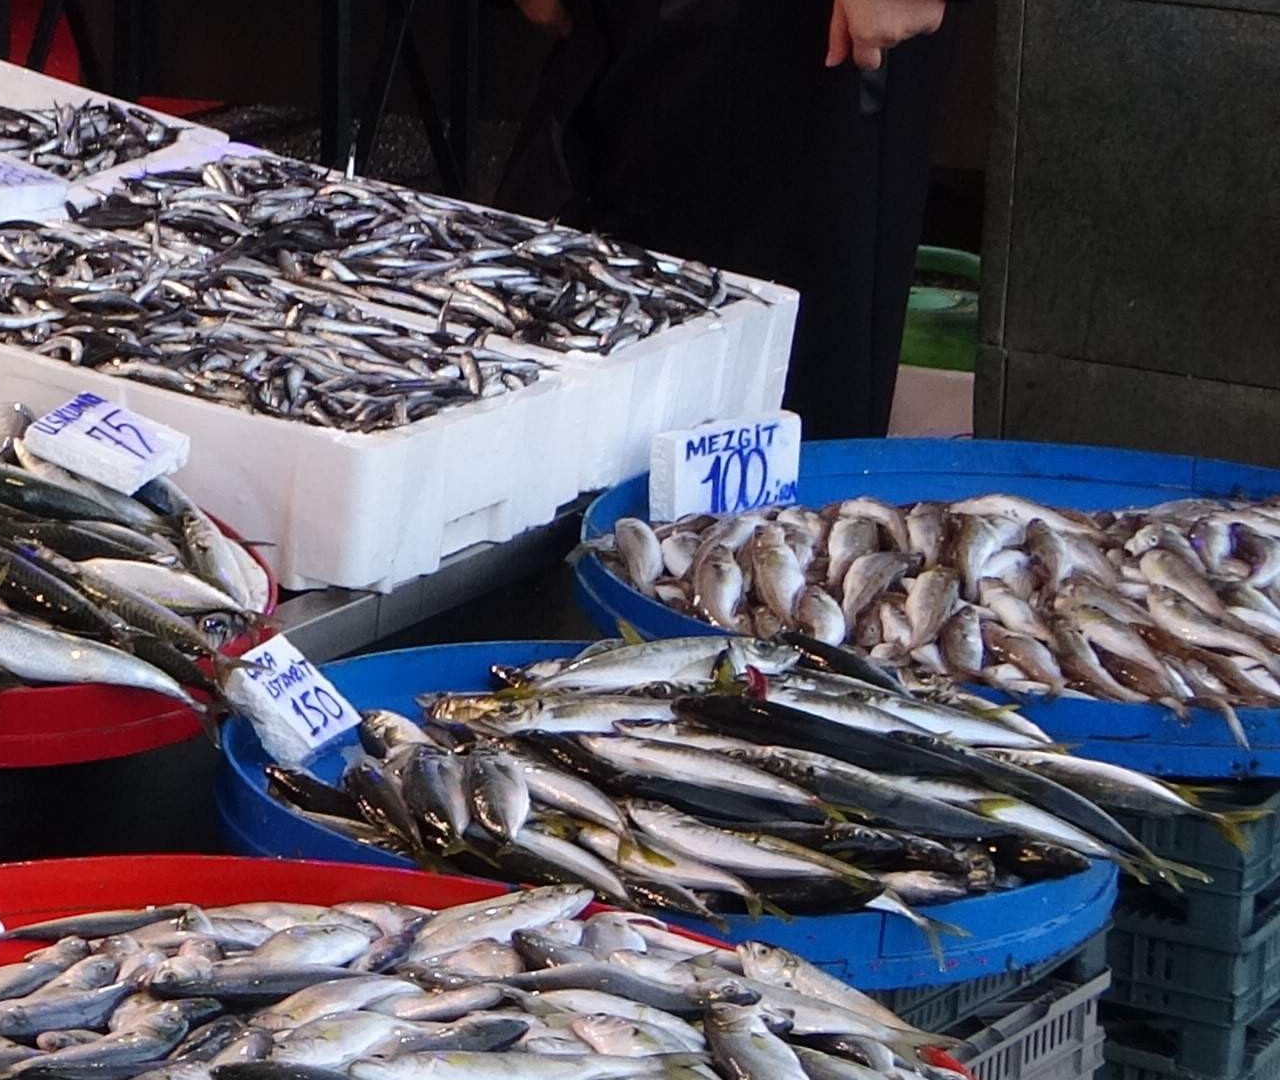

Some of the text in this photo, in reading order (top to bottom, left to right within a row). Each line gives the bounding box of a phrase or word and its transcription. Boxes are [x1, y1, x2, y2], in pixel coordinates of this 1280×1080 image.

[85, 409, 154, 460] 75
[701, 447, 767, 513] 100
[290, 686, 344, 736] 150
